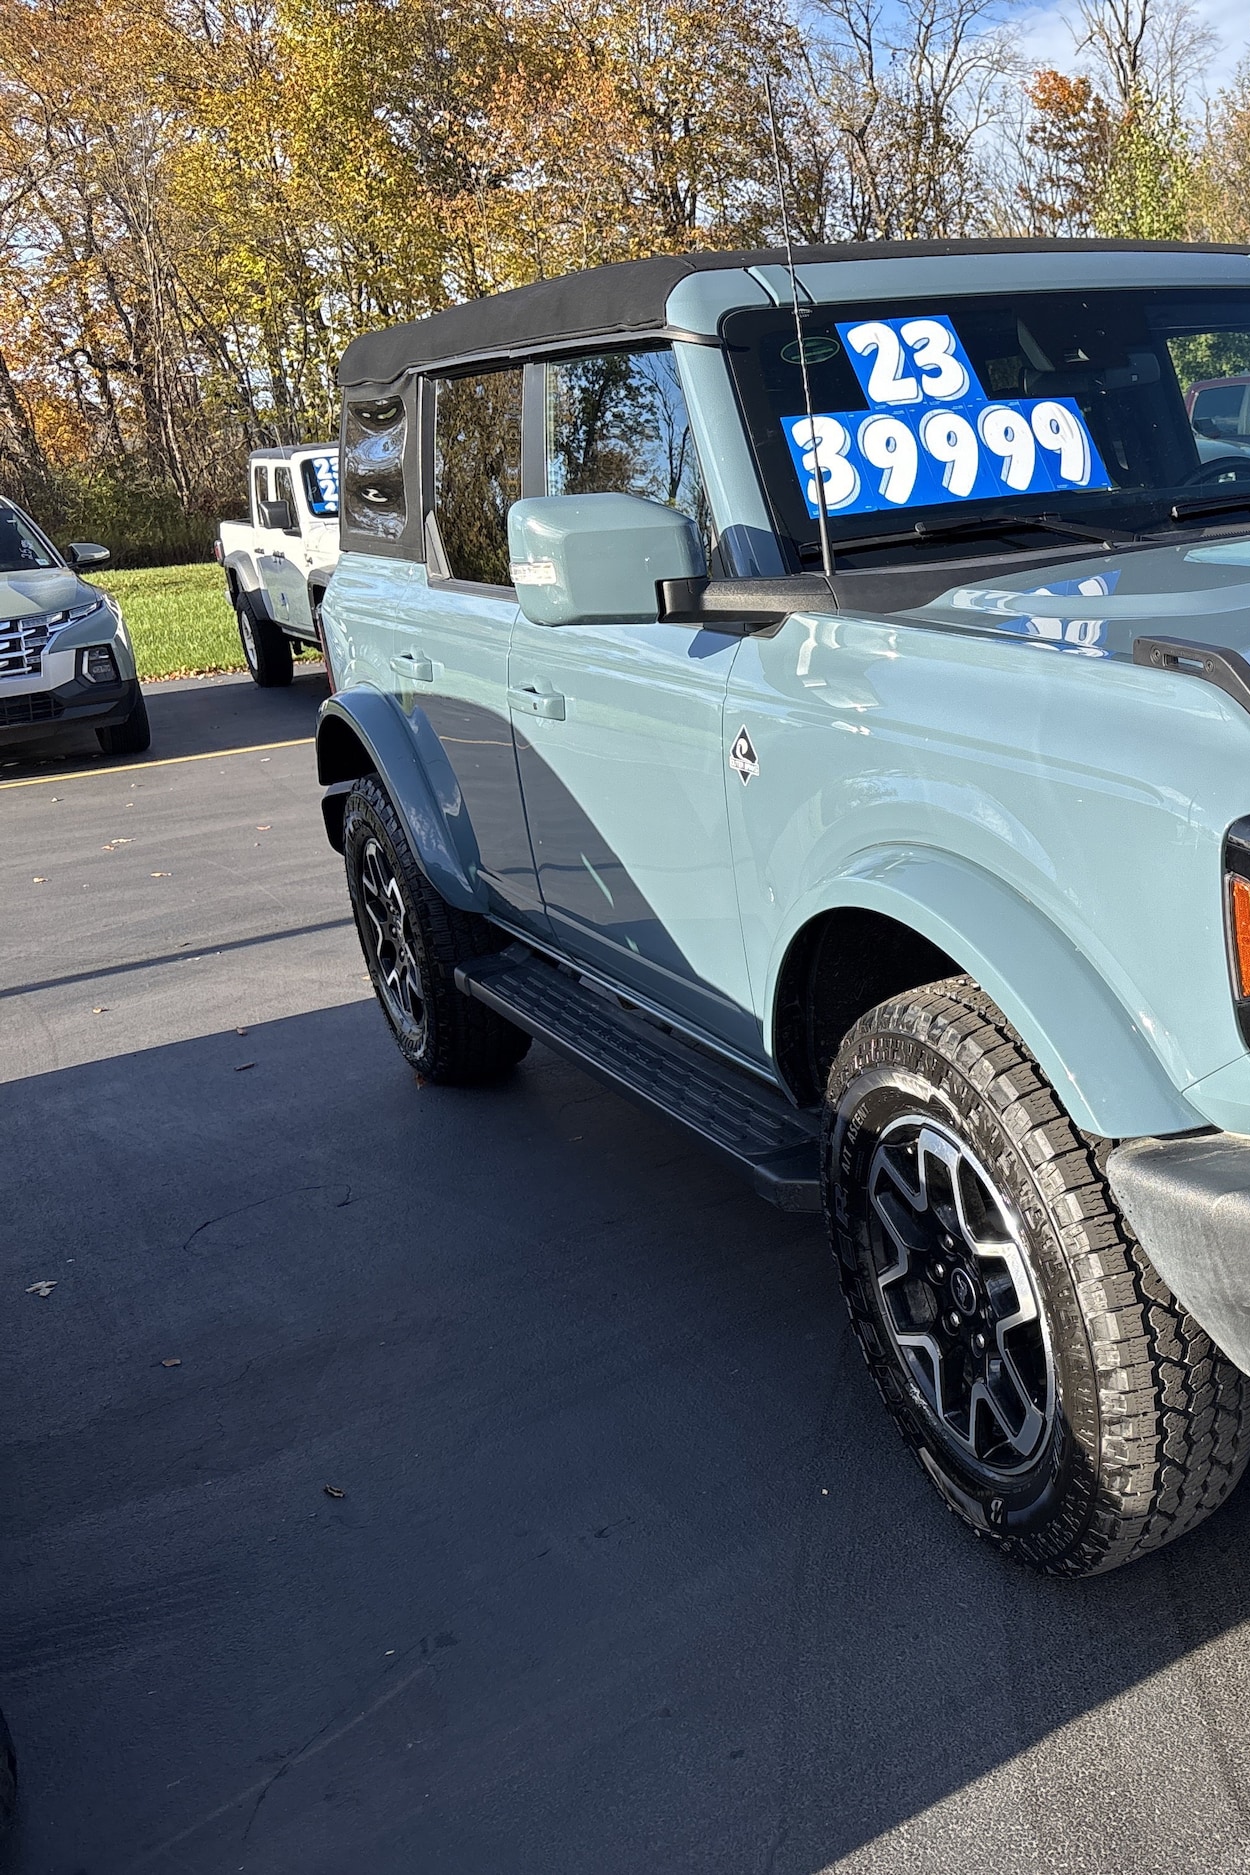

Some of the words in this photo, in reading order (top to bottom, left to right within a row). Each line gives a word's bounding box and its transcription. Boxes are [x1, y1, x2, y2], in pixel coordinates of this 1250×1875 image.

[847, 319, 970, 405] 23
[791, 401, 1091, 510] 39999
[846, 1102, 870, 1145] ASCENT
[841, 1145, 852, 1176] A/T
